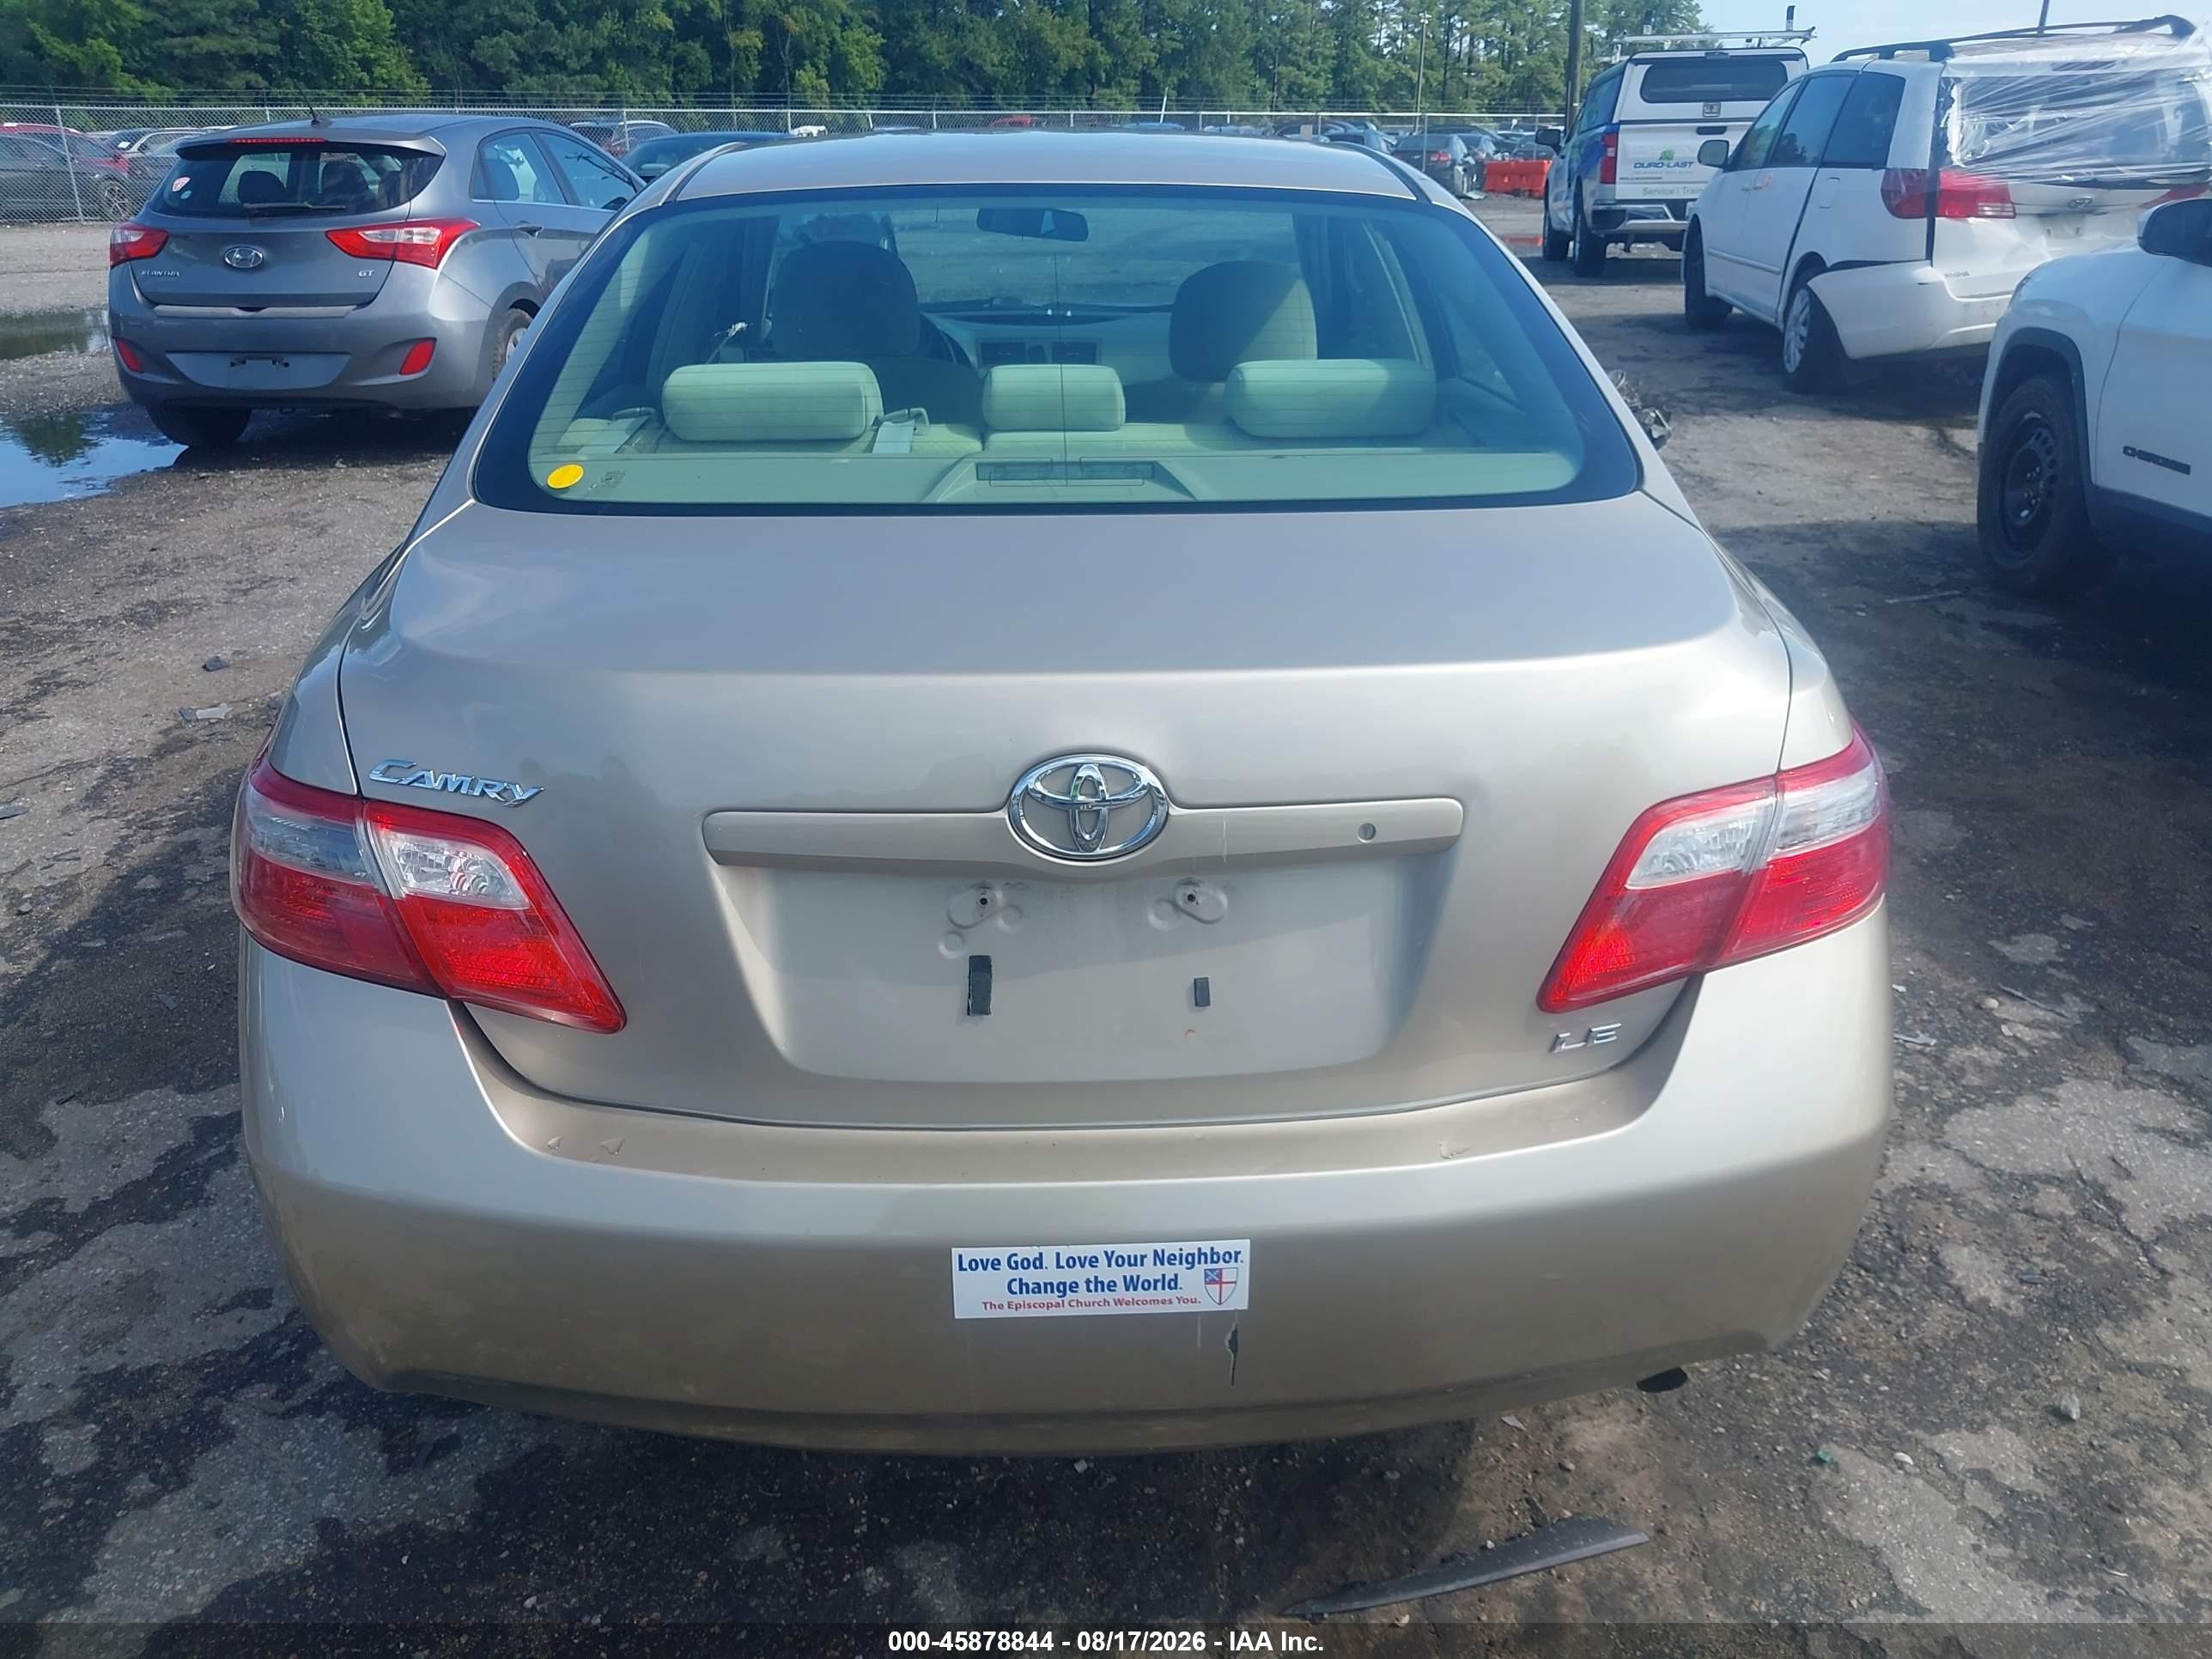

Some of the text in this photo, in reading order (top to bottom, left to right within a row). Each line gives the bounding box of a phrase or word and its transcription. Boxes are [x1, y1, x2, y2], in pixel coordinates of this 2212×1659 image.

[1642, 186, 1674, 196] Service
[358, 269, 374, 277] GT
[369, 759, 545, 807] CAMRY
[1549, 1023, 1622, 1053] LE
[958, 1246, 1244, 1272] Love God. Love Your Neighbor.
[1007, 1273, 1183, 1298] Change the World.
[982, 1295, 1201, 1311] The Episcopal Church Welcomes You.
